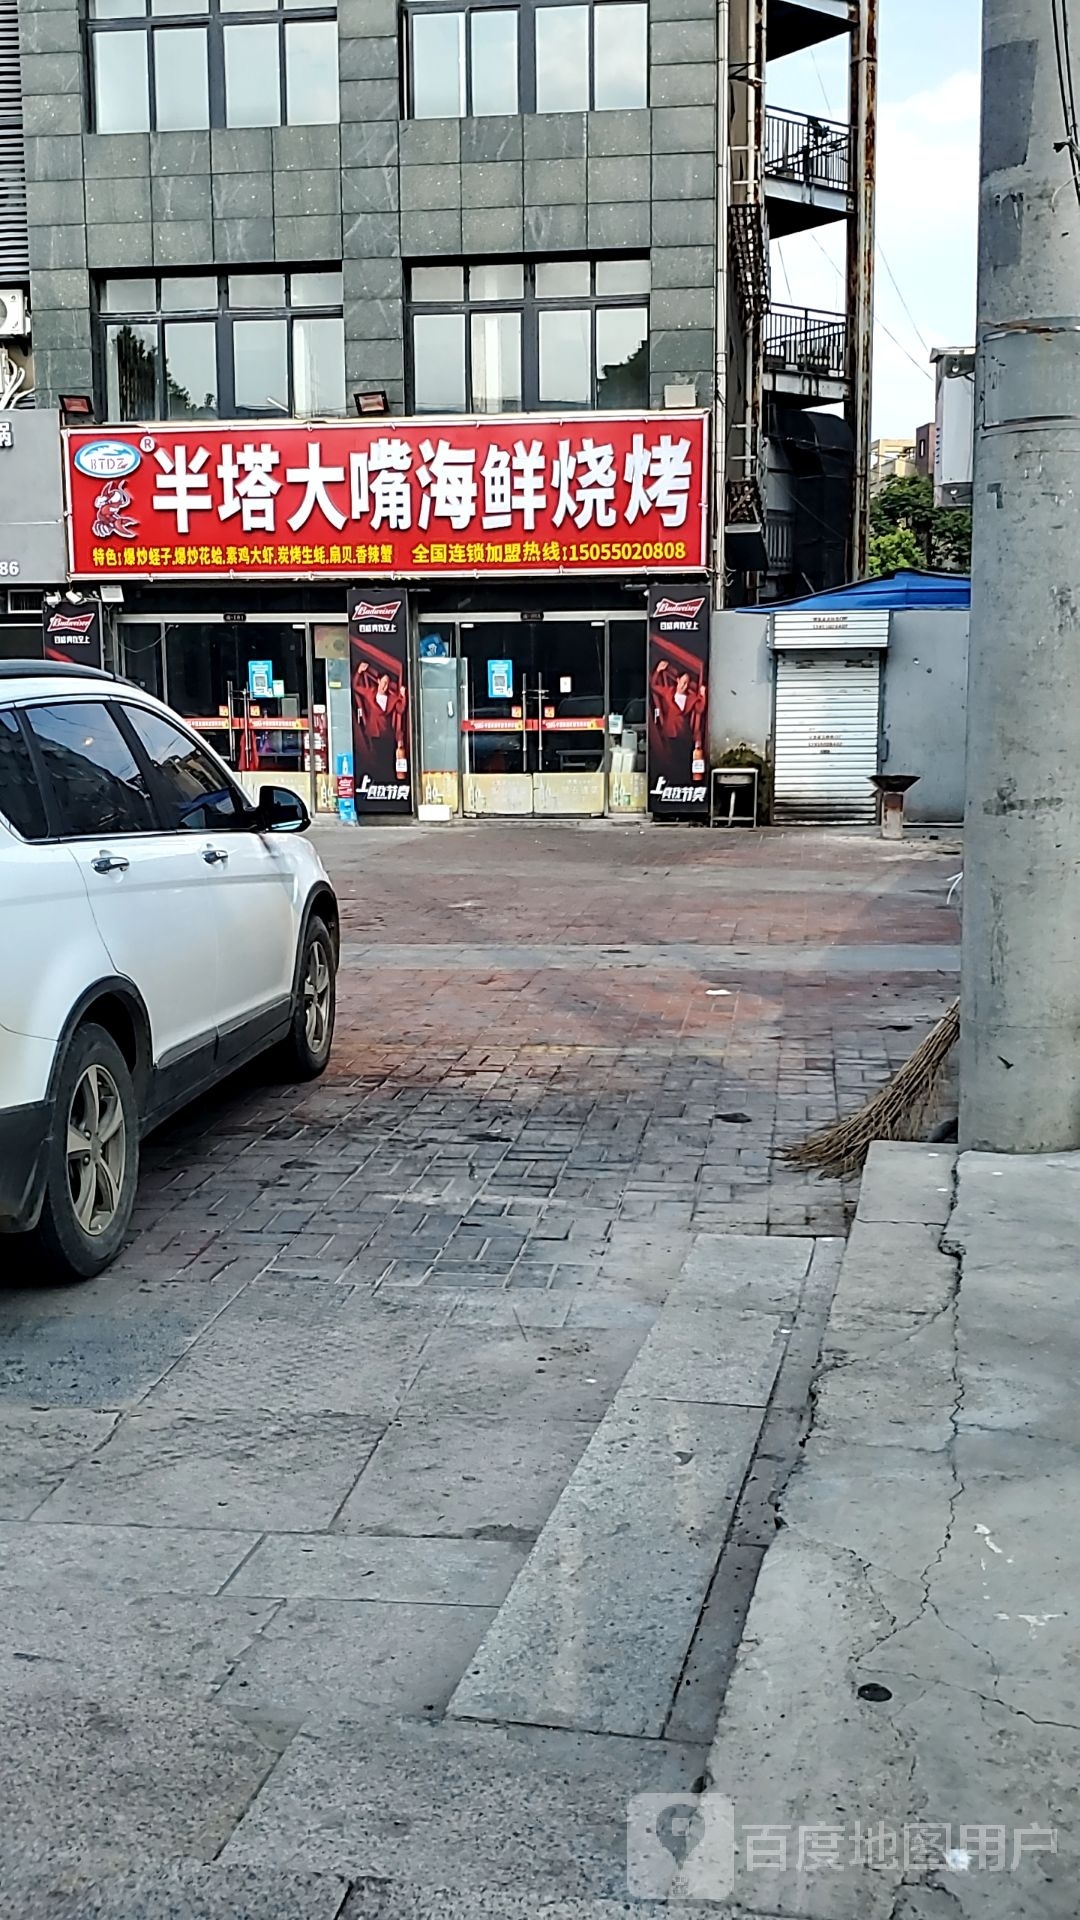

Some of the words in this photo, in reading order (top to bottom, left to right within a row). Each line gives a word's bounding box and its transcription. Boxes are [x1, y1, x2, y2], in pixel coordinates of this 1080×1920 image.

[153, 433, 692, 534] 半塔大嘴海鲜烧烤
[656, 601, 700, 613] Budweiser
